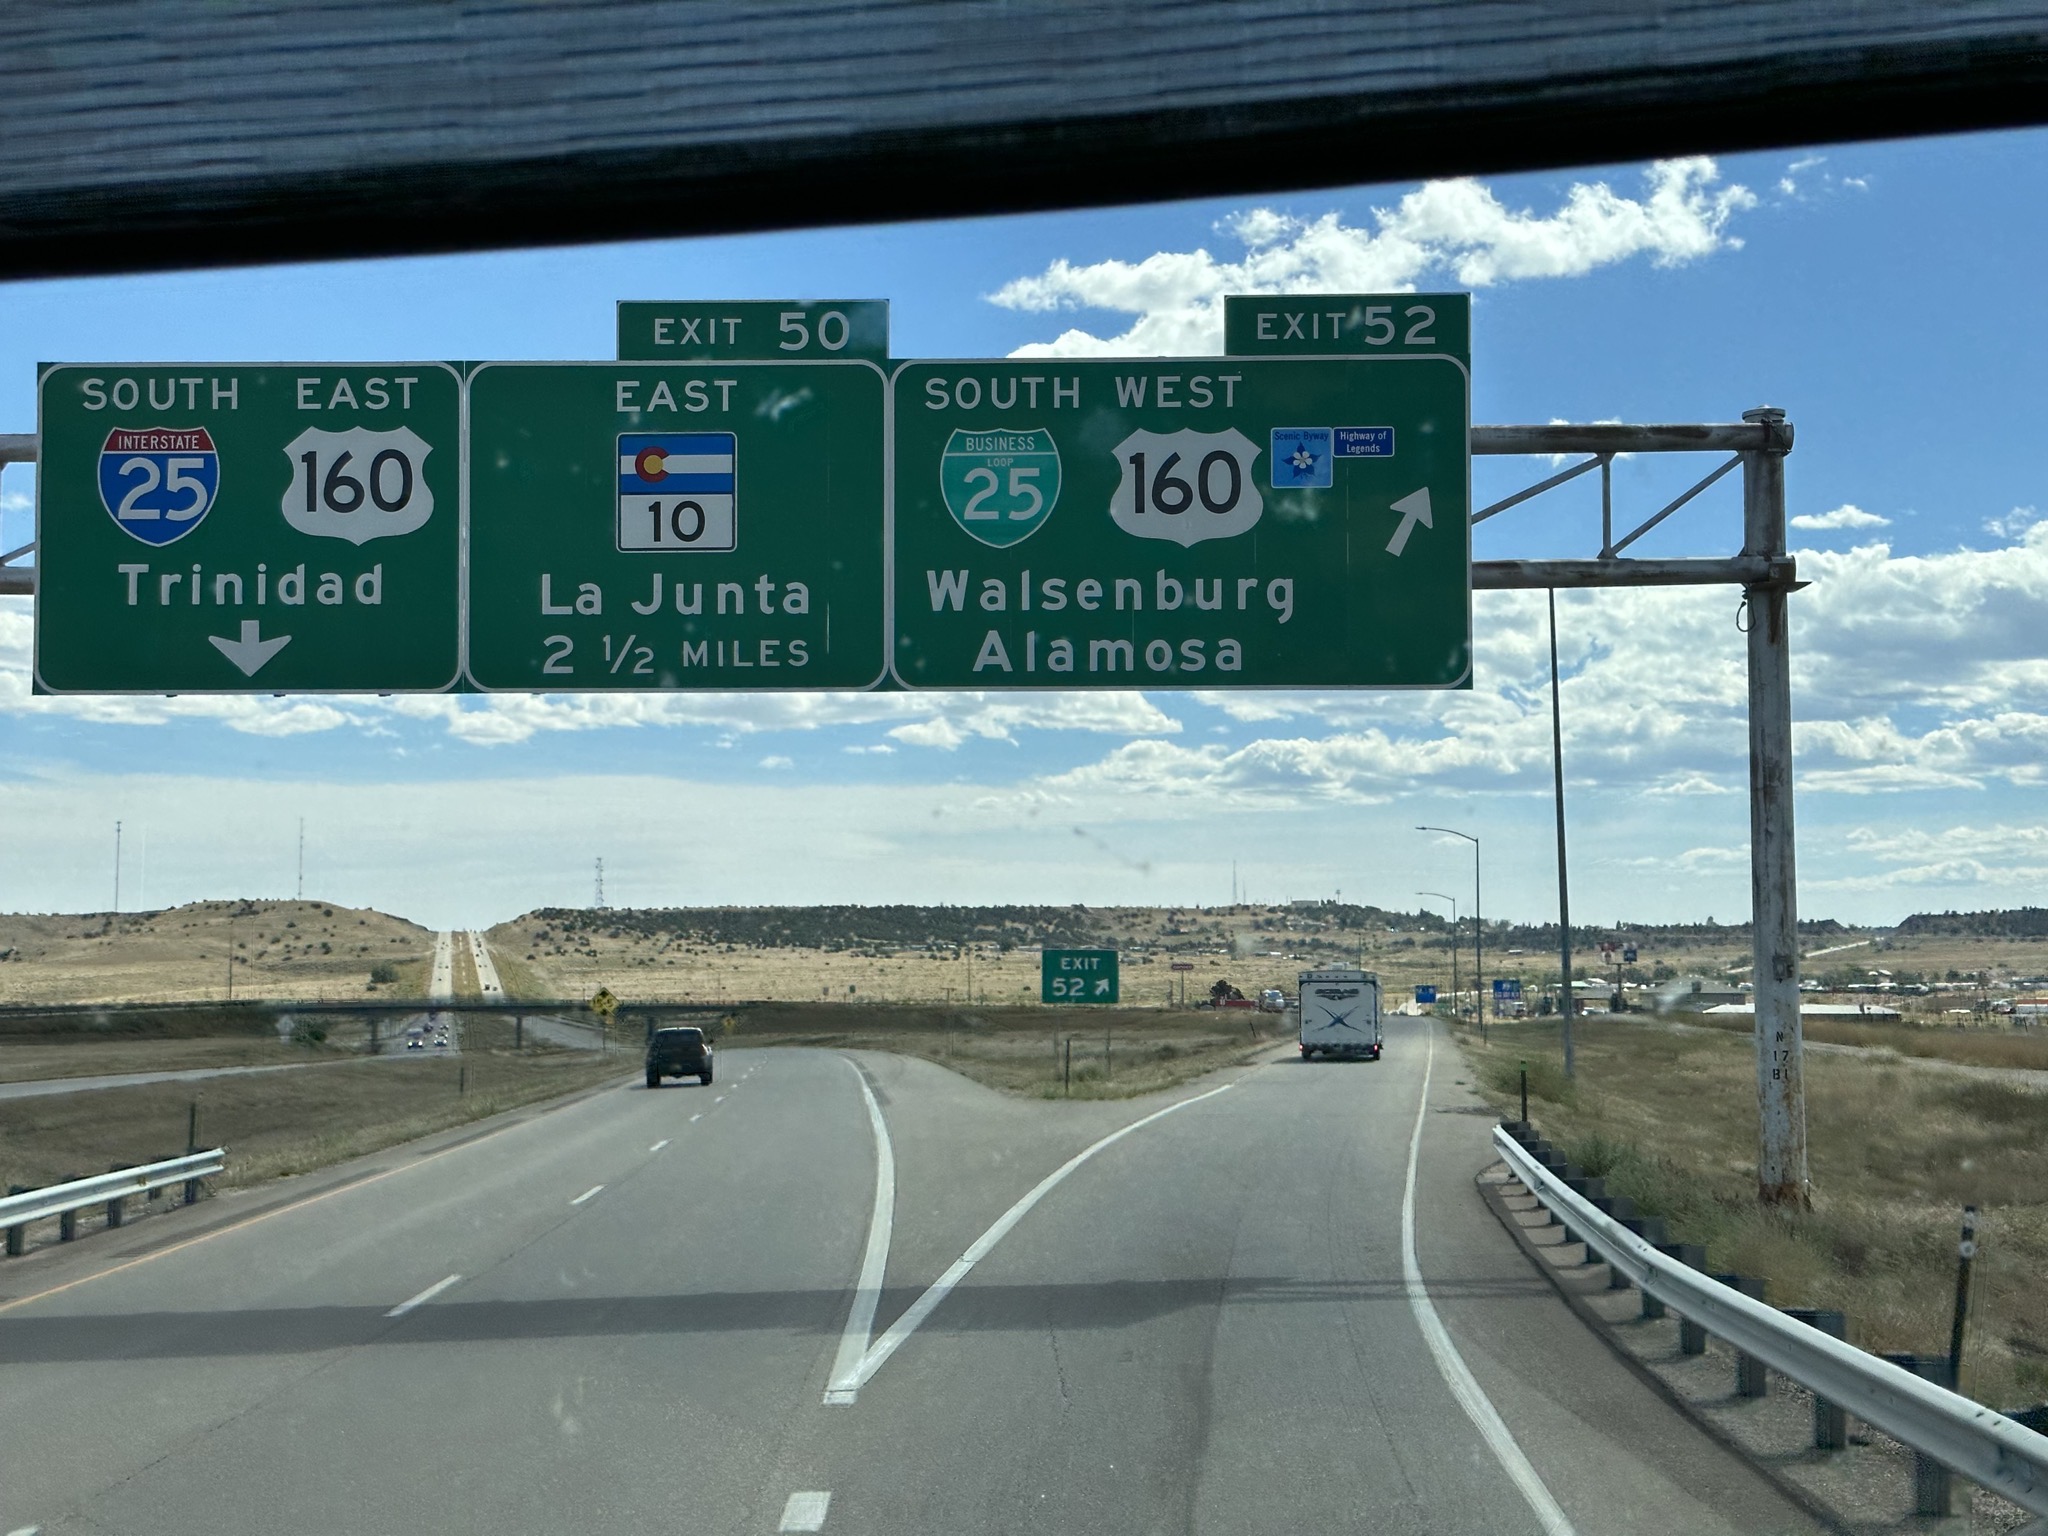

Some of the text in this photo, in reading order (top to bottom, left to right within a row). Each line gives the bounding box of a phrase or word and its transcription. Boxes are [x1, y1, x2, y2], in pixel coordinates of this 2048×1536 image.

[653, 310, 850, 352] EXIT 50
[1257, 305, 1437, 346] EXIT 52
[82, 377, 419, 411] SOUTH EAST
[616, 380, 738, 413] EAST
[924, 375, 1242, 410] SOUTH WEST
[118, 434, 200, 450] INTERSTATE
[966, 437, 1035, 451] BUSINESS
[1274, 431, 1329, 442] Scenic Byway
[1340, 431, 1387, 442] Highway of
[1346, 444, 1380, 454] Legends
[300, 448, 414, 513] 160
[987, 458, 1014, 467] LOOP
[117, 457, 208, 521] 25
[963, 467, 1043, 521] 25
[1129, 450, 1242, 515] 160
[648, 500, 706, 543] 10
[118, 563, 382, 605] Trinidad
[541, 573, 810, 615] La Junta
[927, 569, 1294, 624] Walsenburg
[543, 635, 574, 674] 2
[682, 640, 809, 667] MILES
[973, 630, 1242, 671] Alamosa
[1061, 957, 1101, 970] EXIT
[1052, 977, 1085, 996] 52
[1775, 1031, 1784, 1042] N
